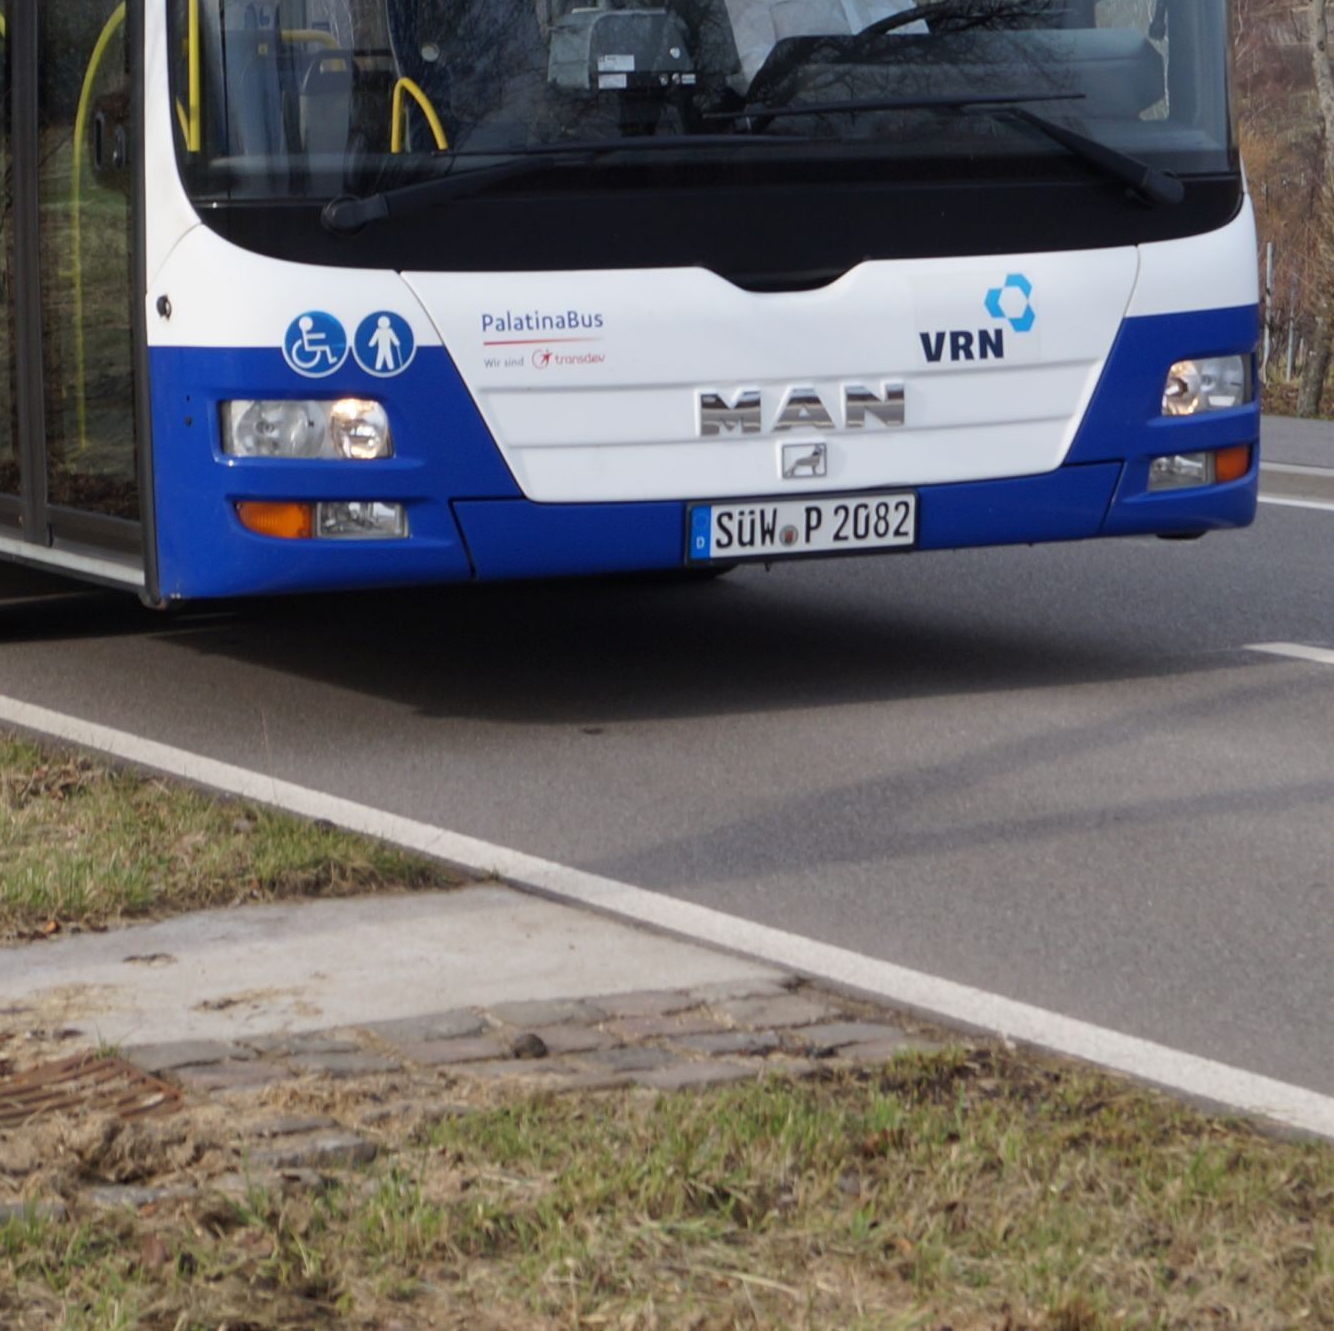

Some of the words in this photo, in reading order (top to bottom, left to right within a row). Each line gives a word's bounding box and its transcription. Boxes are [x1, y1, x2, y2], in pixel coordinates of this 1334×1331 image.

[482, 310, 604, 332] PalatinaBus
[919, 328, 1005, 363] VRN
[484, 357, 501, 368] Wir
[504, 355, 525, 367] sind
[555, 352, 606, 365] transdev
[695, 380, 906, 437] MAN
[804, 506, 822, 544] P
[833, 500, 911, 542] 2082
[696, 535, 705, 549] D
